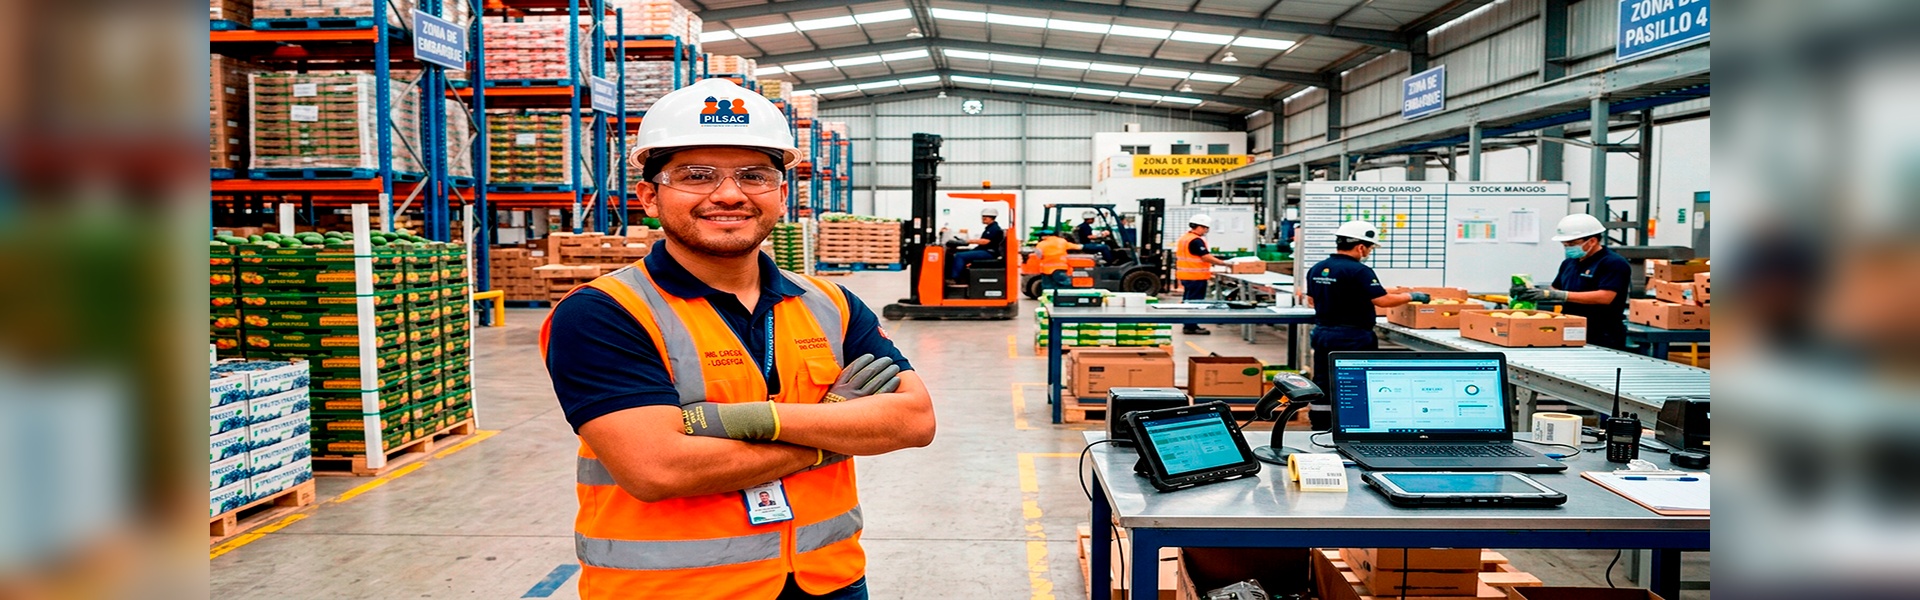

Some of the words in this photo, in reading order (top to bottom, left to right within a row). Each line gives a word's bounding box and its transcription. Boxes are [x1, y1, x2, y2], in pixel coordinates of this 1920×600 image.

[1630, 0, 1675, 22] ZONA
[1625, 11, 1692, 49] PASILLO
[1695, 6, 1709, 27] 4
[704, 115, 745, 123] PILSAC
[1171, 157, 1183, 165] DE
[1139, 168, 1180, 176] MANGOS
